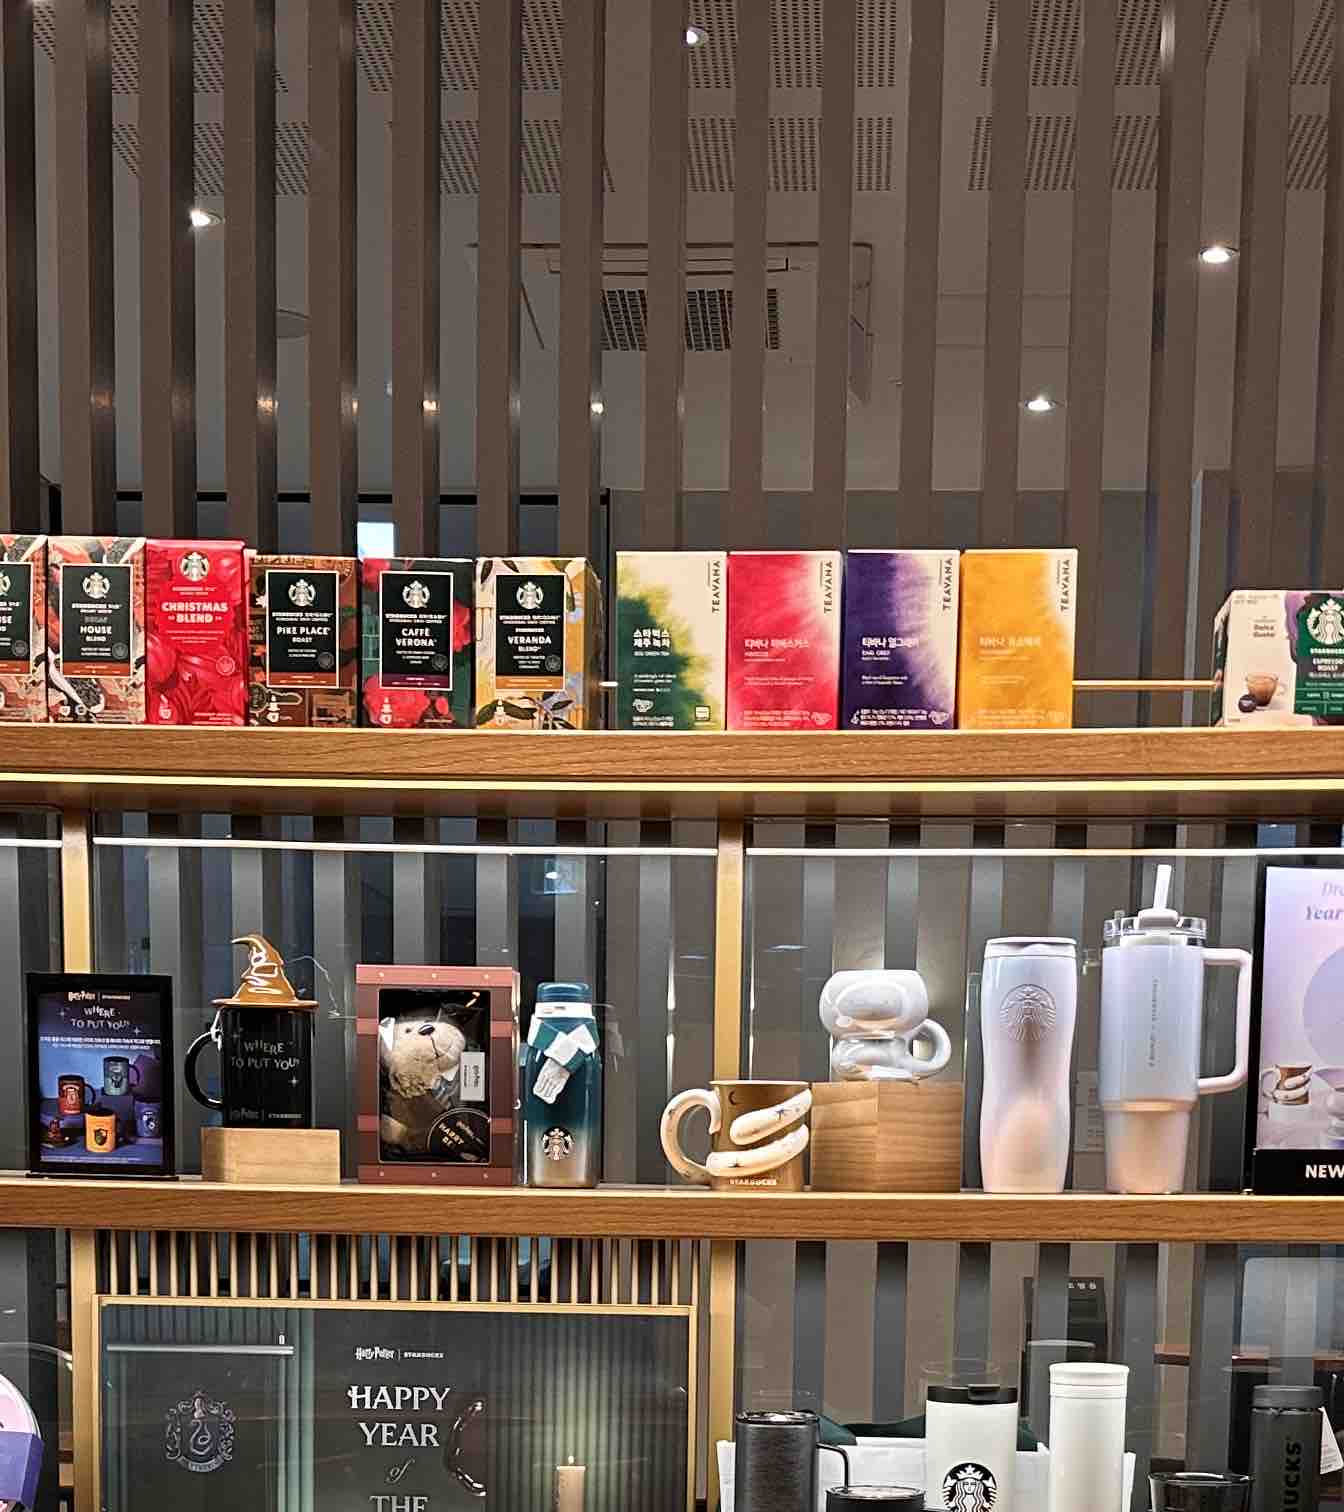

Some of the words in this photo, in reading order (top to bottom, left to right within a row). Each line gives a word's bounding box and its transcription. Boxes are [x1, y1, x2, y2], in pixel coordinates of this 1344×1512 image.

[711, 559, 721, 614] TEAVANA
[823, 560, 834, 615] TEAVANA
[942, 556, 953, 611] TEAVANA
[1060, 556, 1071, 613] TEAVANA
[161, 601, 229, 612] CHRISTMAS
[176, 612, 214, 624] BLEND
[80, 625, 113, 635] HOUSE
[276, 626, 298, 636] PIKE
[507, 635, 552, 646] VERANDA
[632, 638, 651, 649] 제주
[1303, 904, 1344, 922] Year
[83, 1004, 116, 1020] WHERE
[70, 1018, 85, 1029] TO
[86, 1018, 106, 1030] PUT
[243, 1039, 287, 1056] WHERE
[247, 1056, 272, 1070] PUT
[355, 1346, 374, 1361] Harry
[374, 1346, 396, 1360] Potter
[403, 1351, 444, 1359] STARBUCKS
[347, 1384, 451, 1410] HAPPY
[358, 1422, 440, 1447] YEAR
[385, 1457, 416, 1485] of
